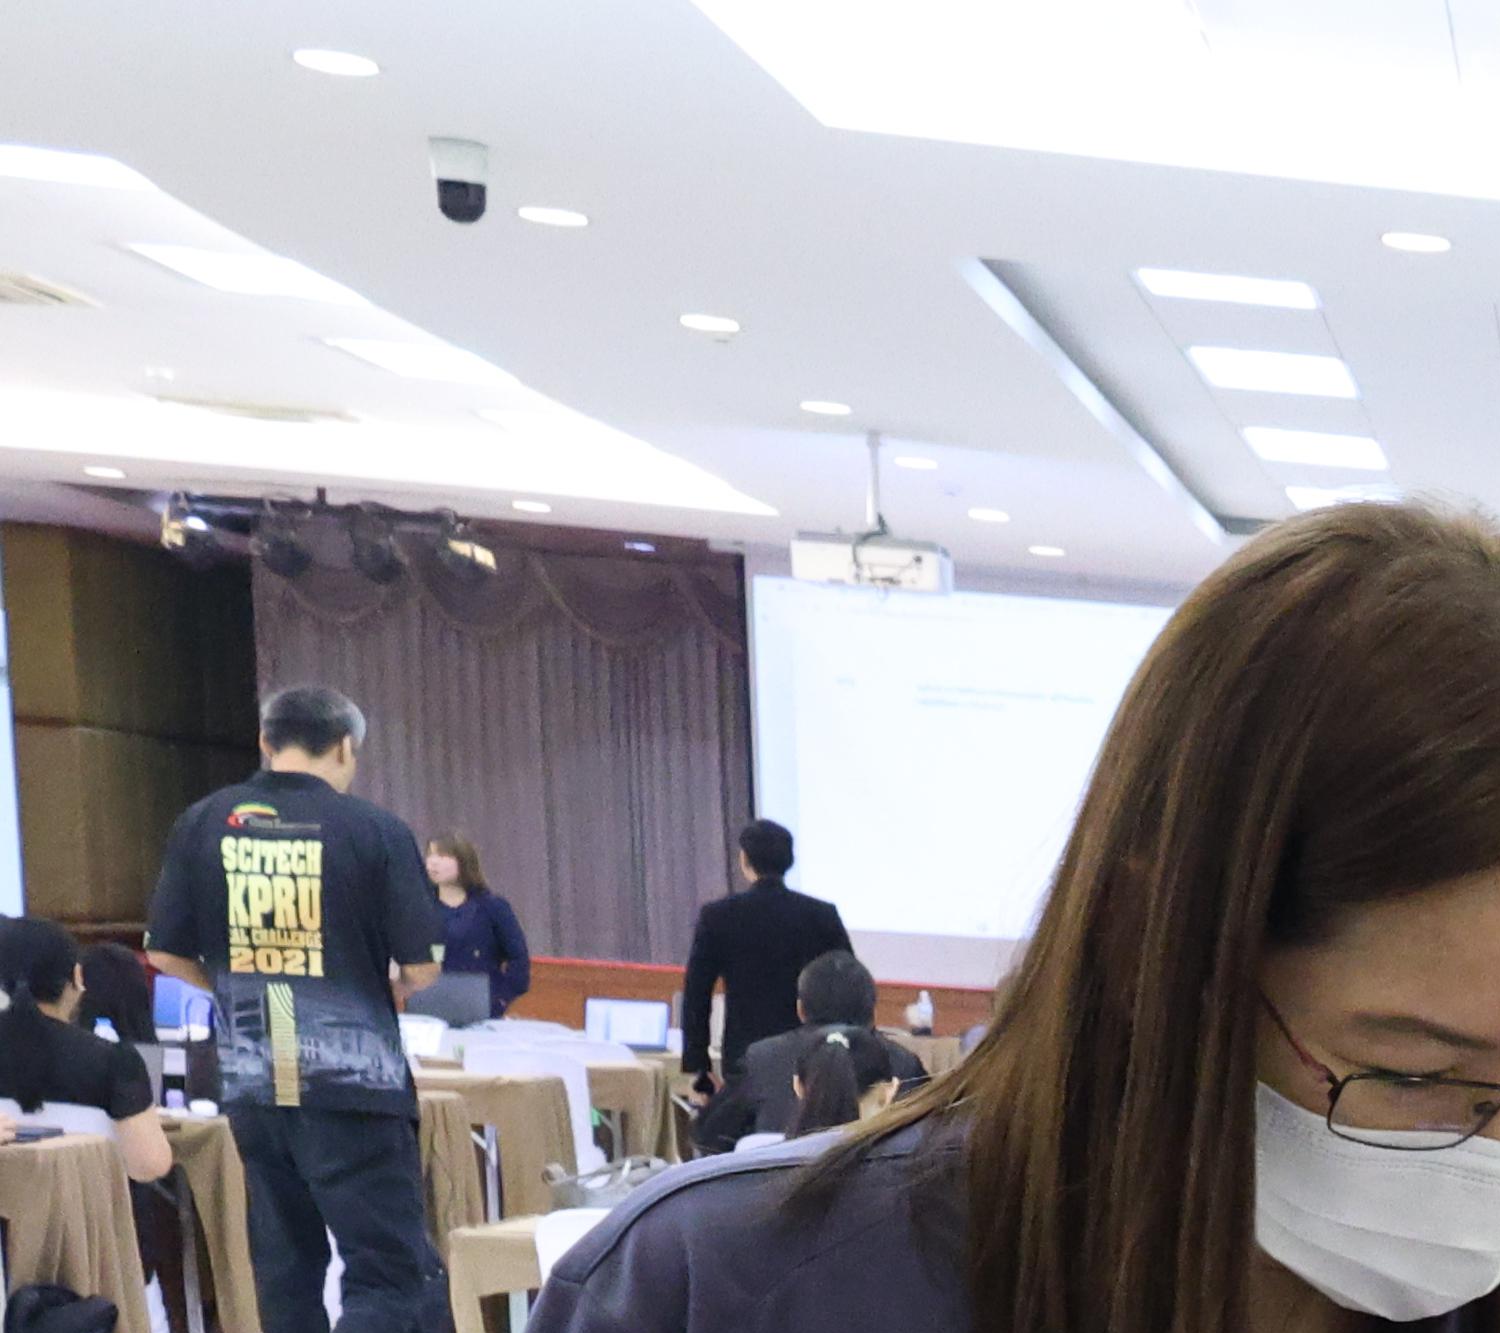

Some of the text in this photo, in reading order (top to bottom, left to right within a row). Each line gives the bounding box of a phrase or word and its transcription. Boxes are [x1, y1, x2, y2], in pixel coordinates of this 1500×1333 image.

[221, 836, 323, 876] SCITECH
[226, 873, 322, 931] KPRU
[230, 946, 324, 976] 2021
